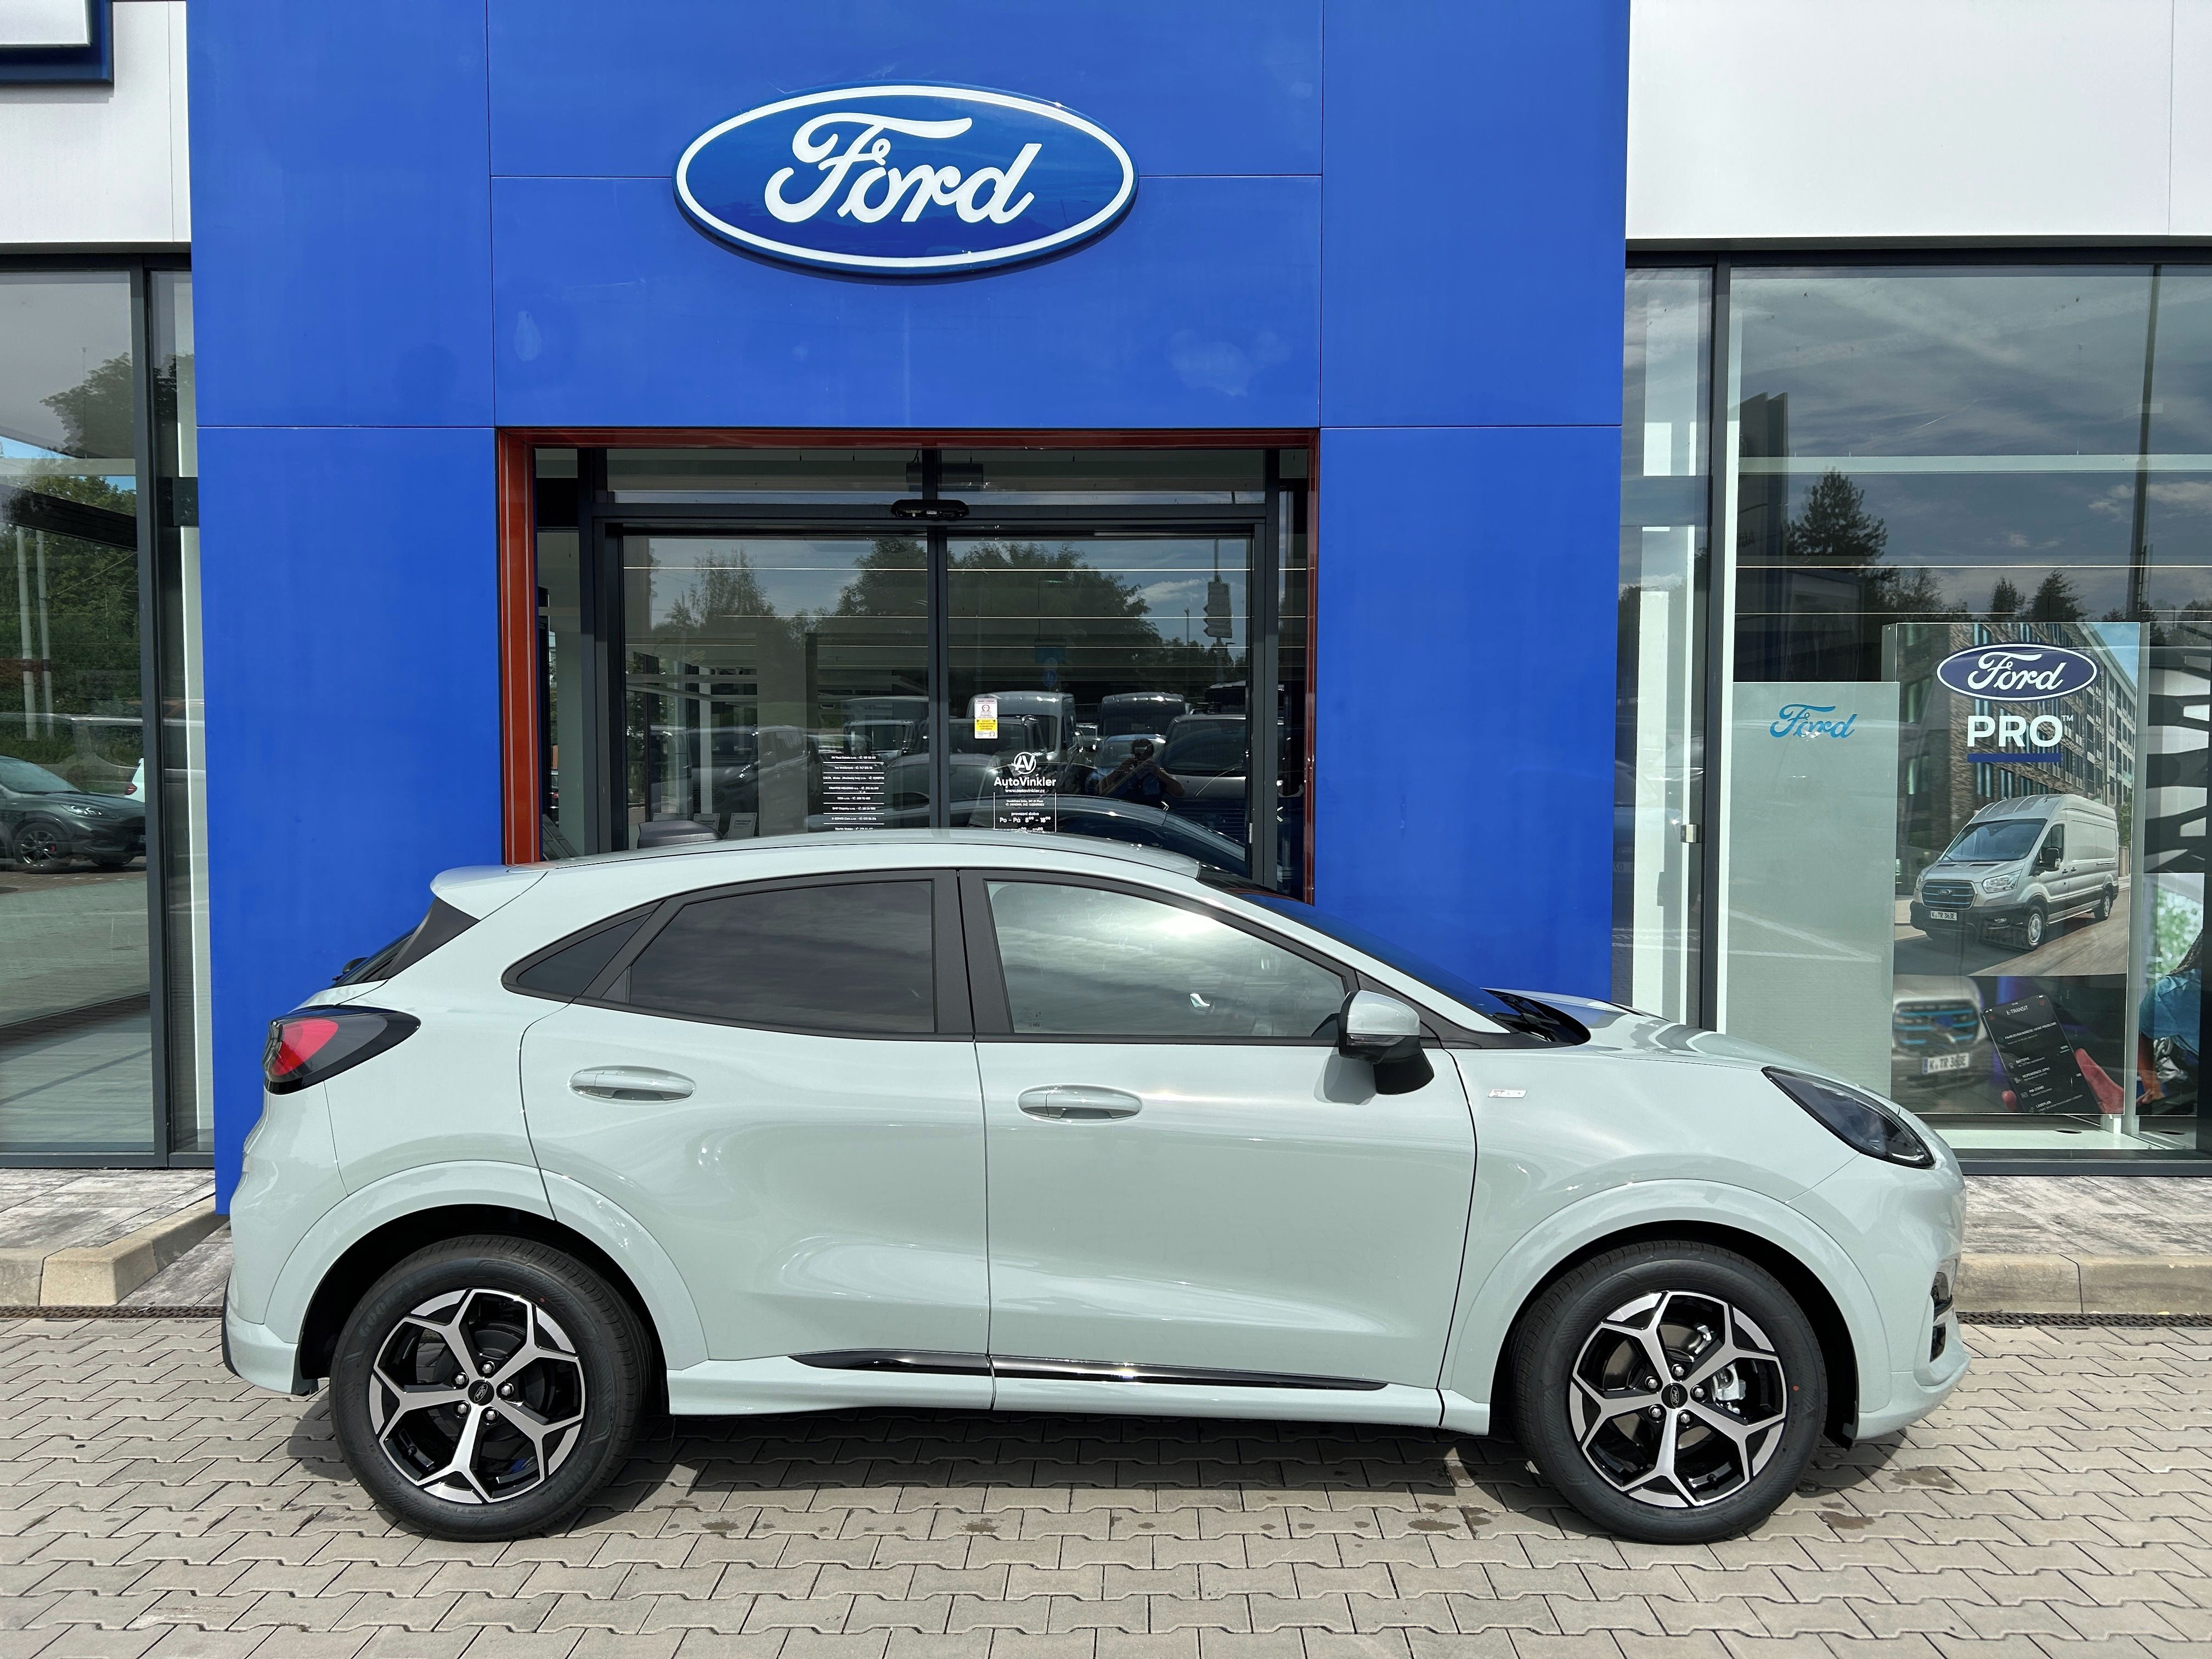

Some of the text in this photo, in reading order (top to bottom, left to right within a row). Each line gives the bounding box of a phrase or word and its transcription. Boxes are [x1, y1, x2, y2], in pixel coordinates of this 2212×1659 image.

[764, 112, 1042, 224] Ford
[1967, 651, 2067, 690] Ford
[1770, 704, 1858, 738] Ford
[1967, 715, 2063, 747] PRO
[994, 776, 1057, 786] AutoVinkler
[2006, 1005, 2028, 1015] E-TRANSIT
